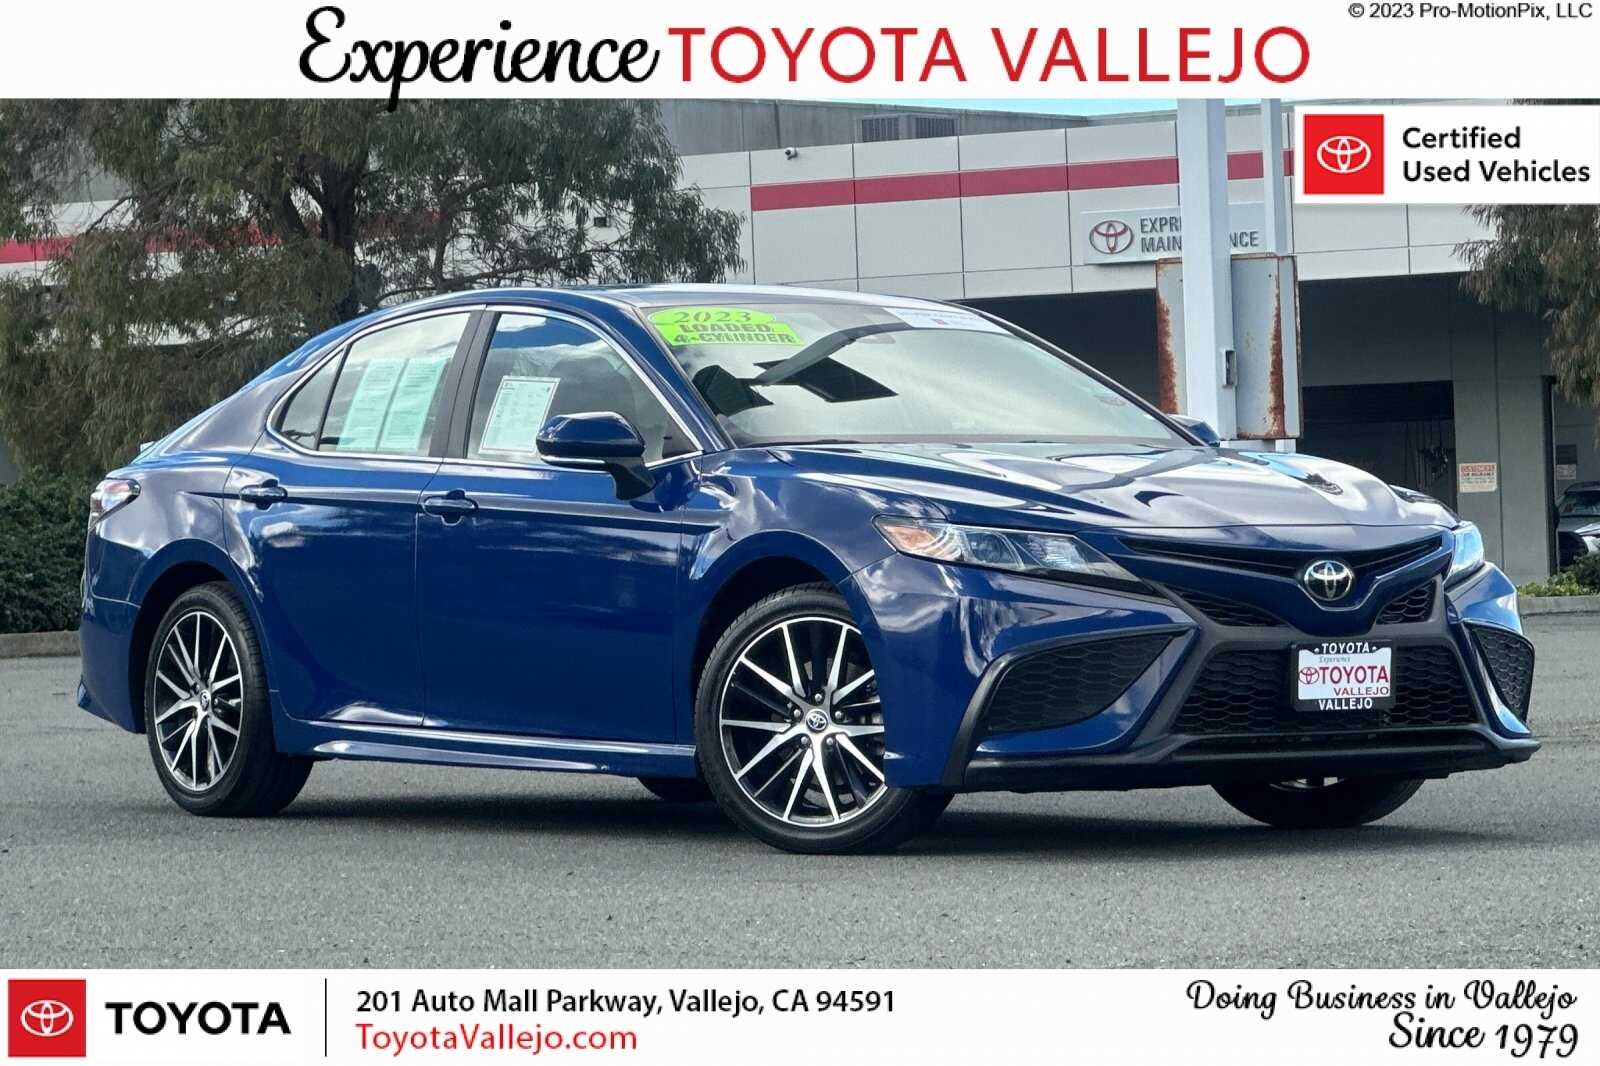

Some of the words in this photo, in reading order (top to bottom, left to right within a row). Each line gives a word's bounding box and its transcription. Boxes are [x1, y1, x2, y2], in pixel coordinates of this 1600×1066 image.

[673, 311, 752, 324] 2023
[673, 333, 794, 344] 4-CYLINDER
[1321, 642, 1370, 654] TOYOTA
[1319, 665, 1389, 684] TOYOTA
[1333, 686, 1389, 696] VALLEJO
[1318, 698, 1373, 711] VALLEJO
